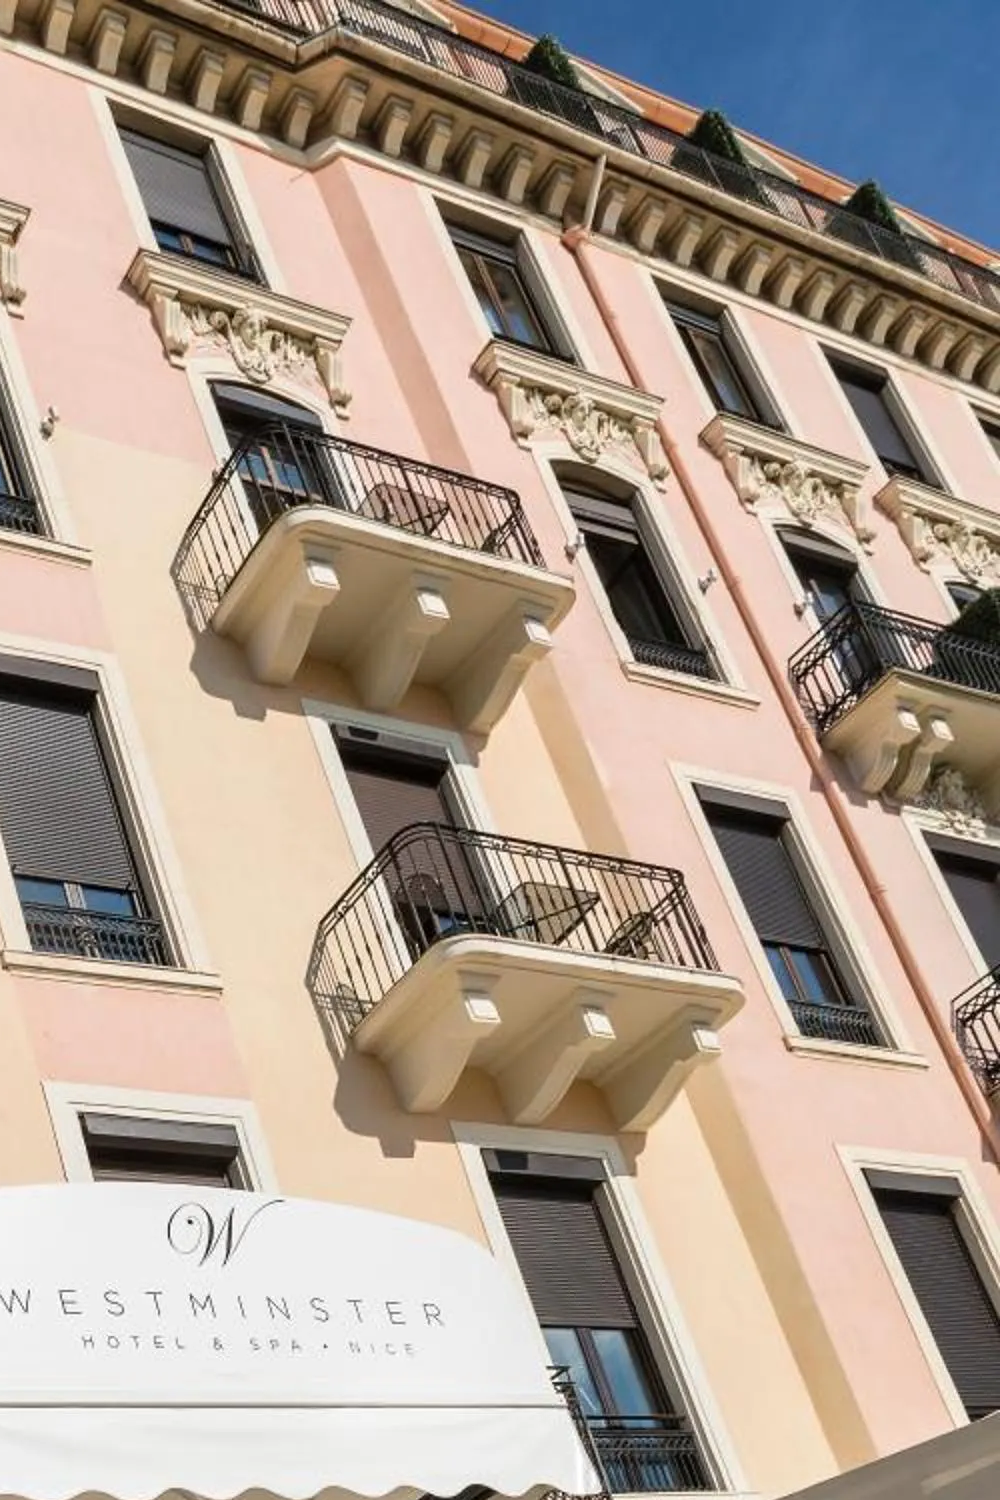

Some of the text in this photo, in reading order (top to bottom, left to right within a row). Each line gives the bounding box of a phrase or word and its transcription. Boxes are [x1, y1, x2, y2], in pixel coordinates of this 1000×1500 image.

[167, 1199, 286, 1267] W
[81, 1334, 415, 1356] HOTEL & SPA NICE
